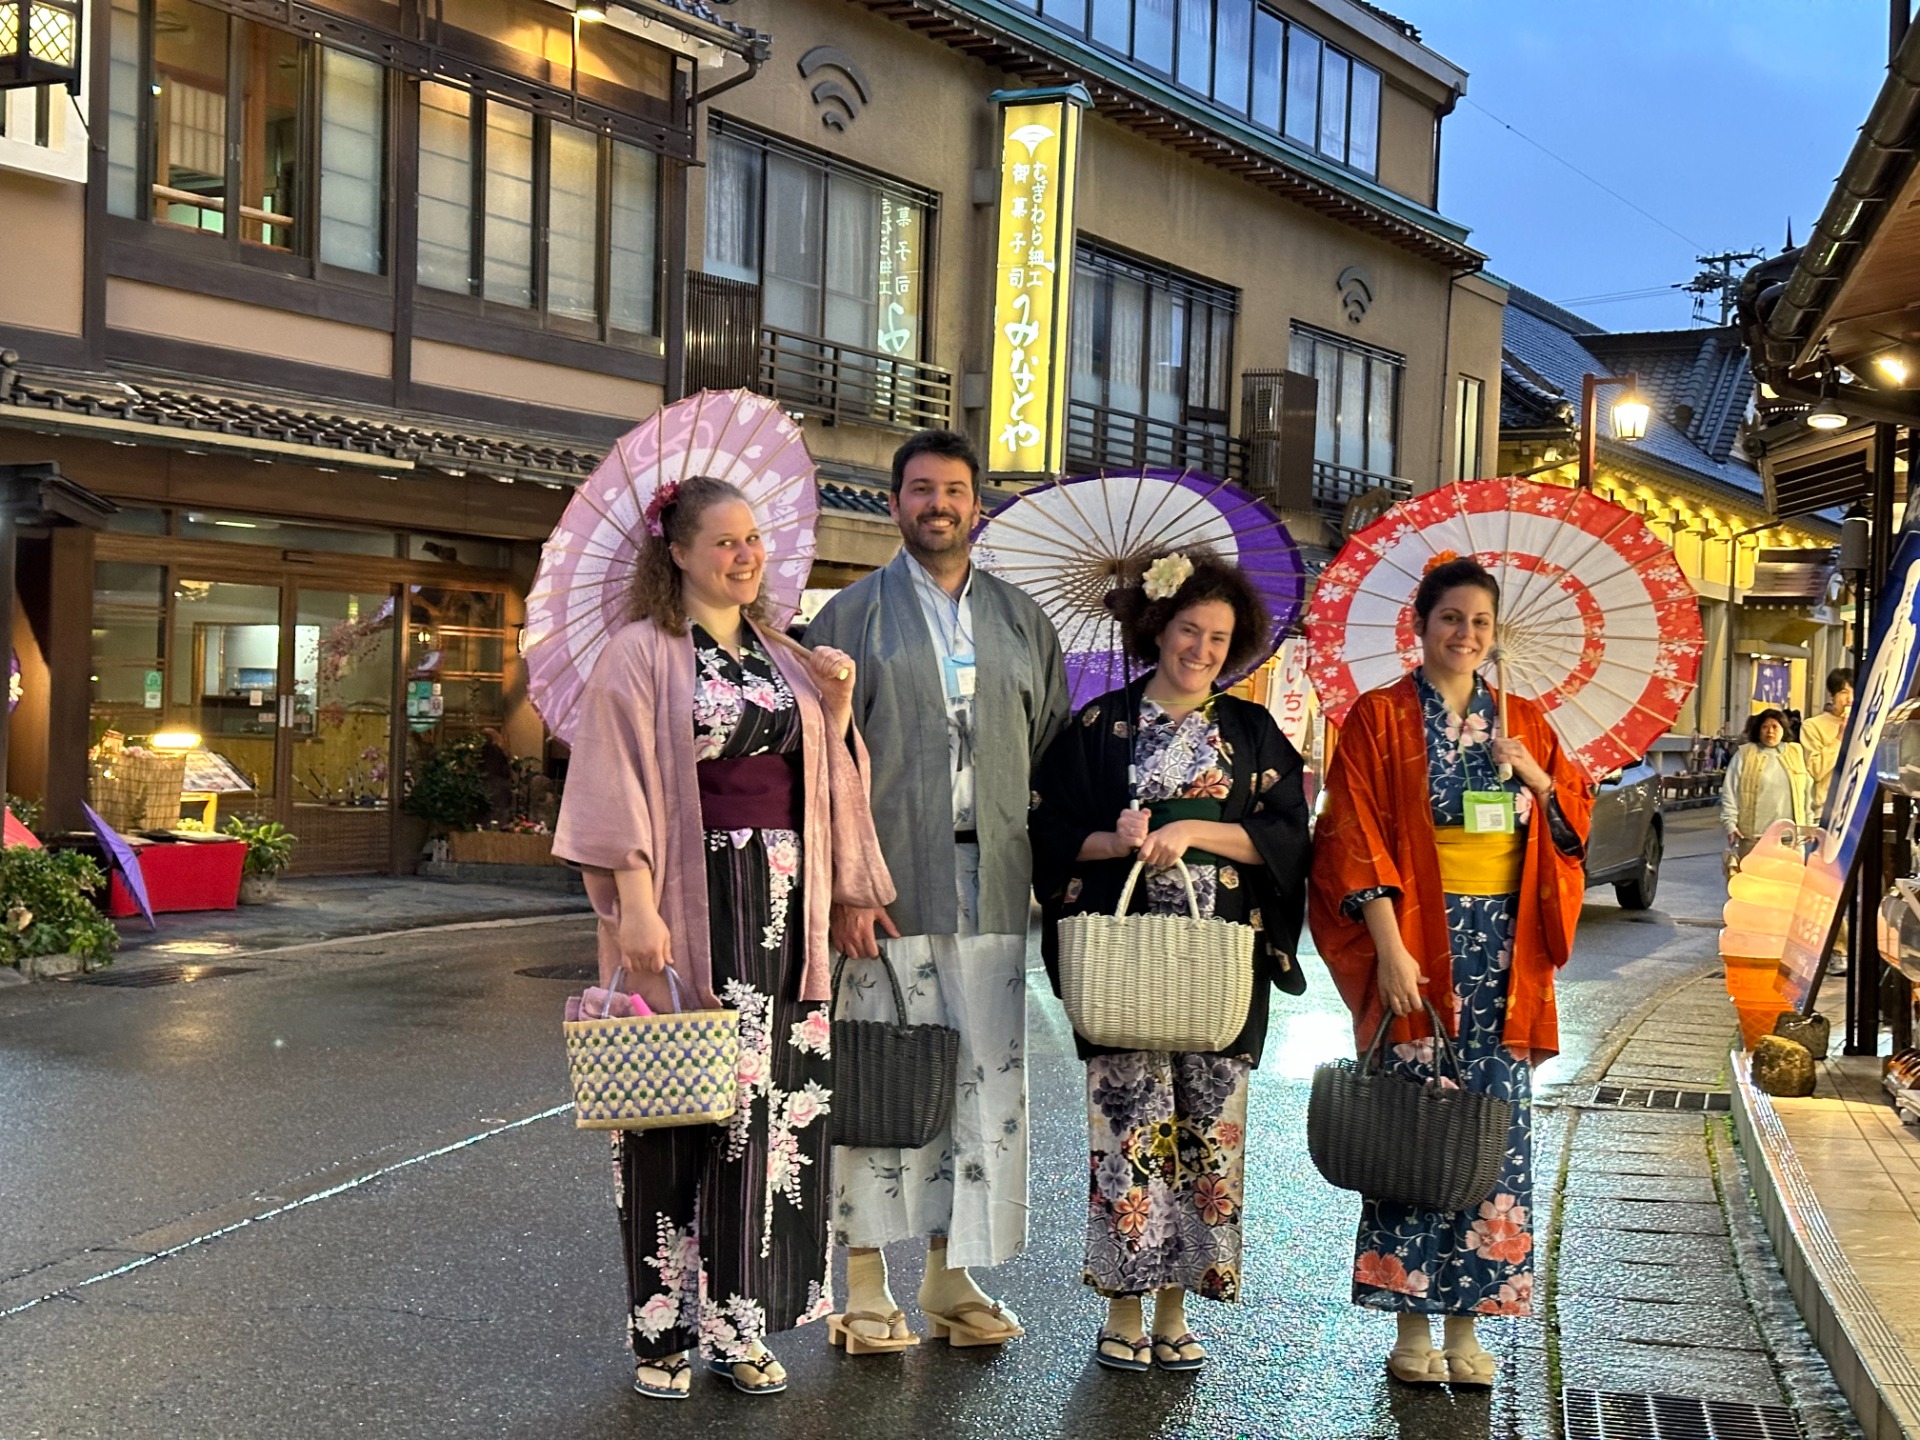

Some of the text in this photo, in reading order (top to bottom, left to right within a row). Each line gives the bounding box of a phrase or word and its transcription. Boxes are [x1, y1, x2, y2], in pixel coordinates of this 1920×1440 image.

[1008, 162, 1030, 289] 御菓子司
[1026, 160, 1049, 288] むぎわら細工
[998, 293, 1041, 452] みなとや
